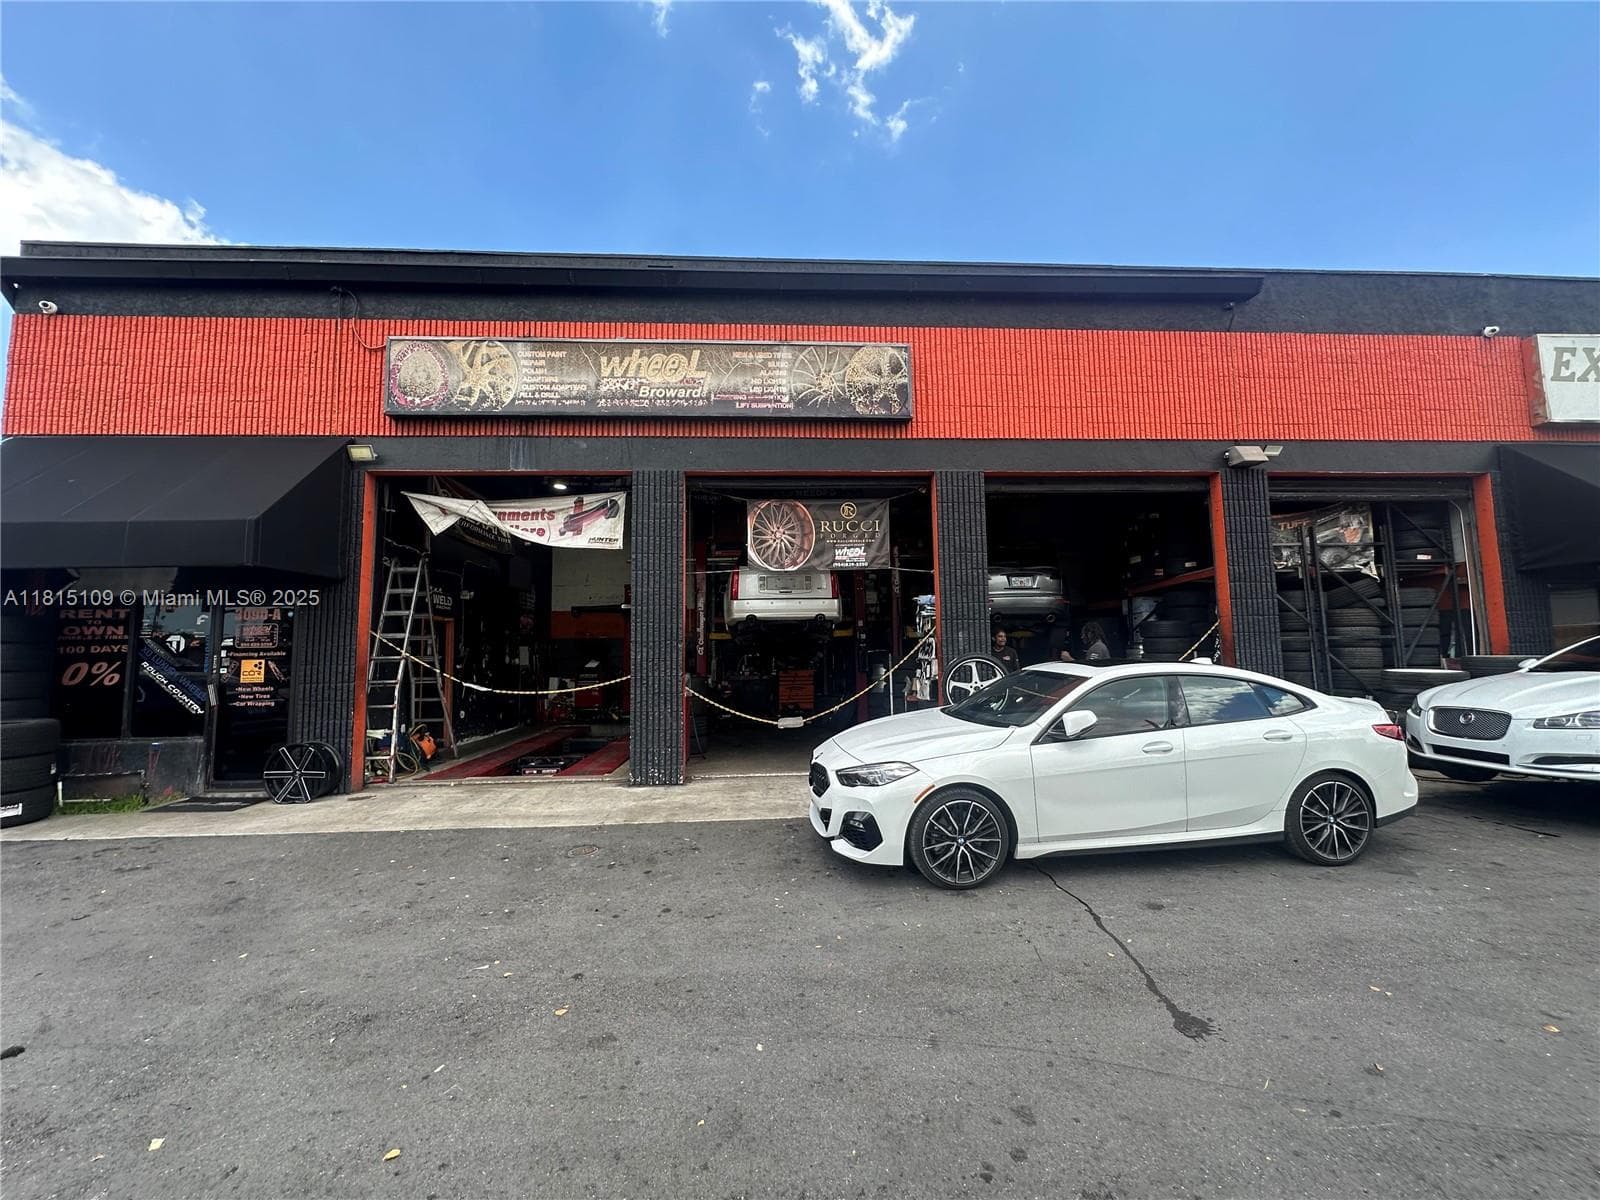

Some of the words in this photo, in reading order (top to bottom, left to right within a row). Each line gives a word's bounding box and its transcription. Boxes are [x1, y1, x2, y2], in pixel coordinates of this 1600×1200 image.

[1550, 347, 1600, 382] EX
[638, 386, 702, 398] Broward
[820, 519, 881, 532] RUCCI
[432, 594, 453, 606] WELD
[59, 608, 130, 619] RENT
[62, 625, 125, 636] OWN
[58, 645, 86, 655] 100
[89, 644, 129, 653] DAYS
[61, 660, 122, 687] 0%
[140, 661, 170, 685] ROUGH
[167, 683, 205, 715] COUNTRY
